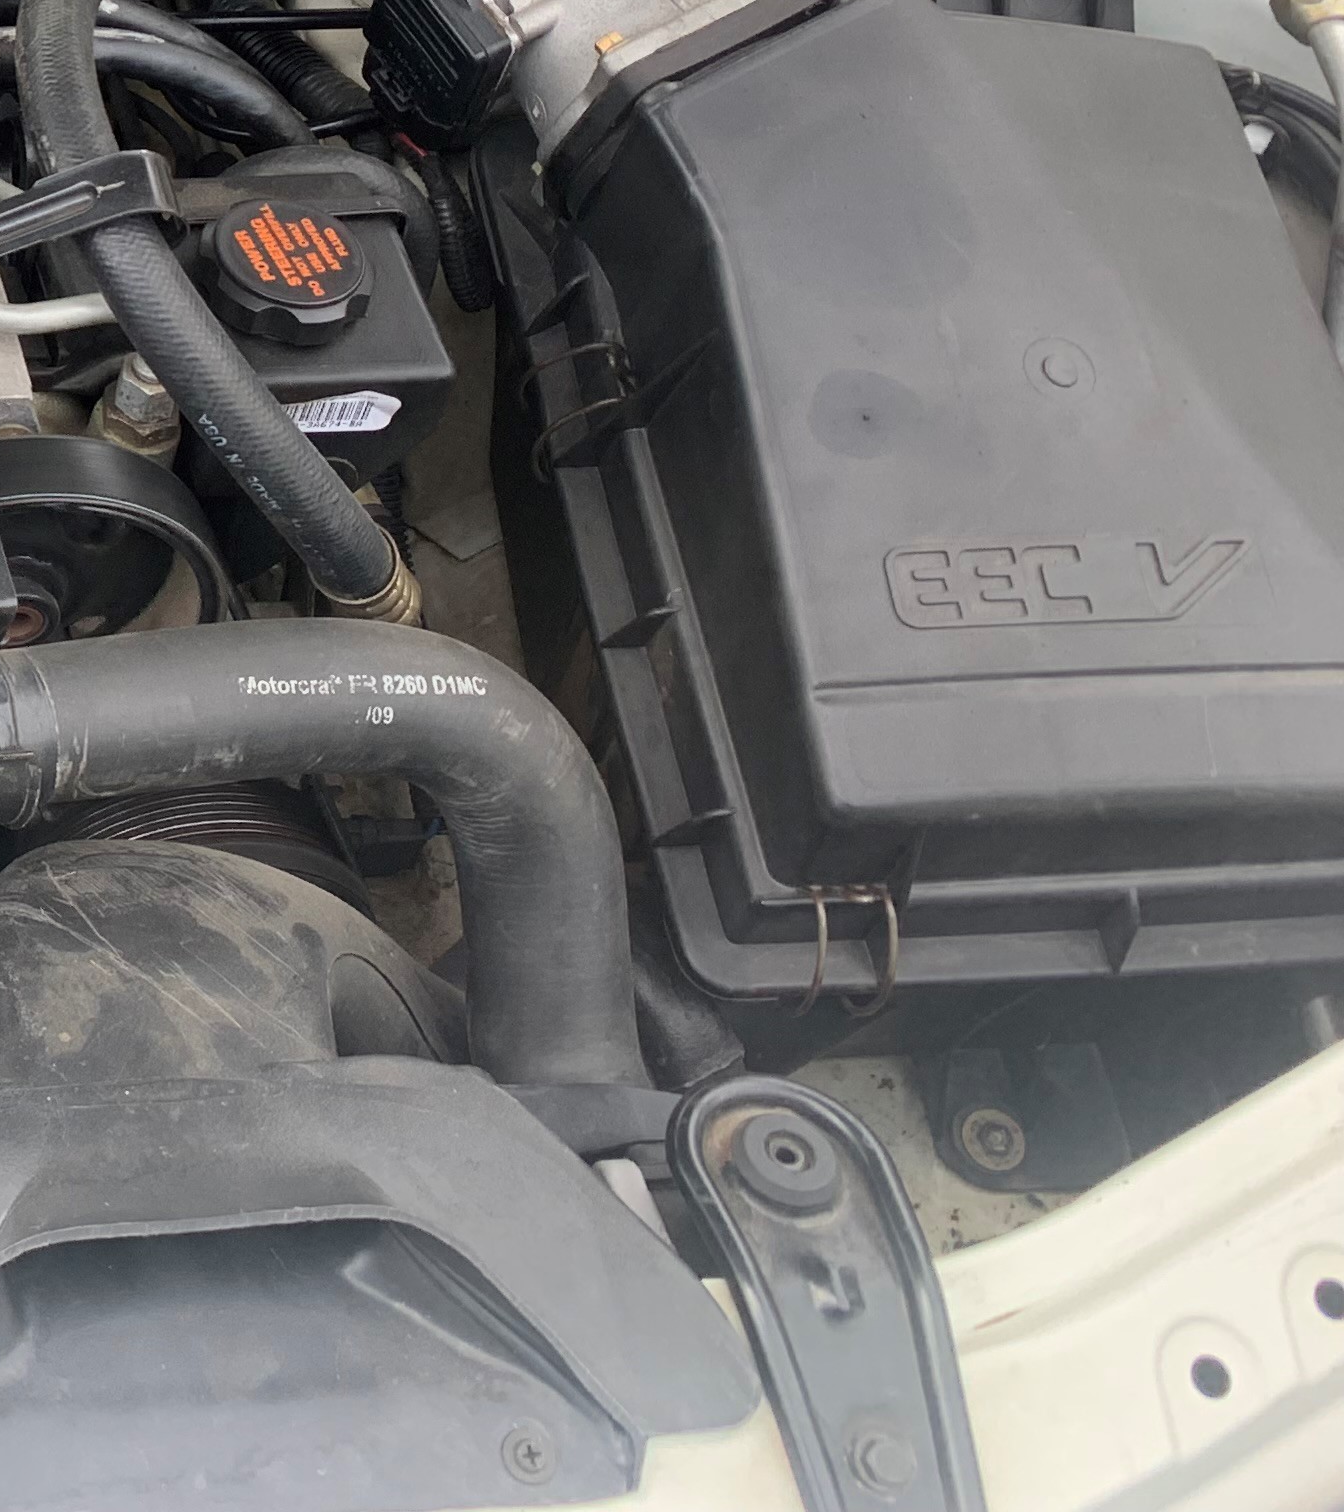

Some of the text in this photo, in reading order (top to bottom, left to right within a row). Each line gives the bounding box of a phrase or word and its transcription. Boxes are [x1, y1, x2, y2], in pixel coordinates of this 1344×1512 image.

[234, 230, 276, 281] POWER
[250, 218, 303, 286] STEERING
[259, 203, 325, 296] DO NOT OVERFILL
[286, 222, 326, 273] USE ONLY
[300, 218, 343, 271] APPROVED
[323, 227, 349, 257] FLUID
[198, 413, 227, 447] USA
[890, 539, 1248, 621] EEC V
[382, 674, 428, 695] 8260
